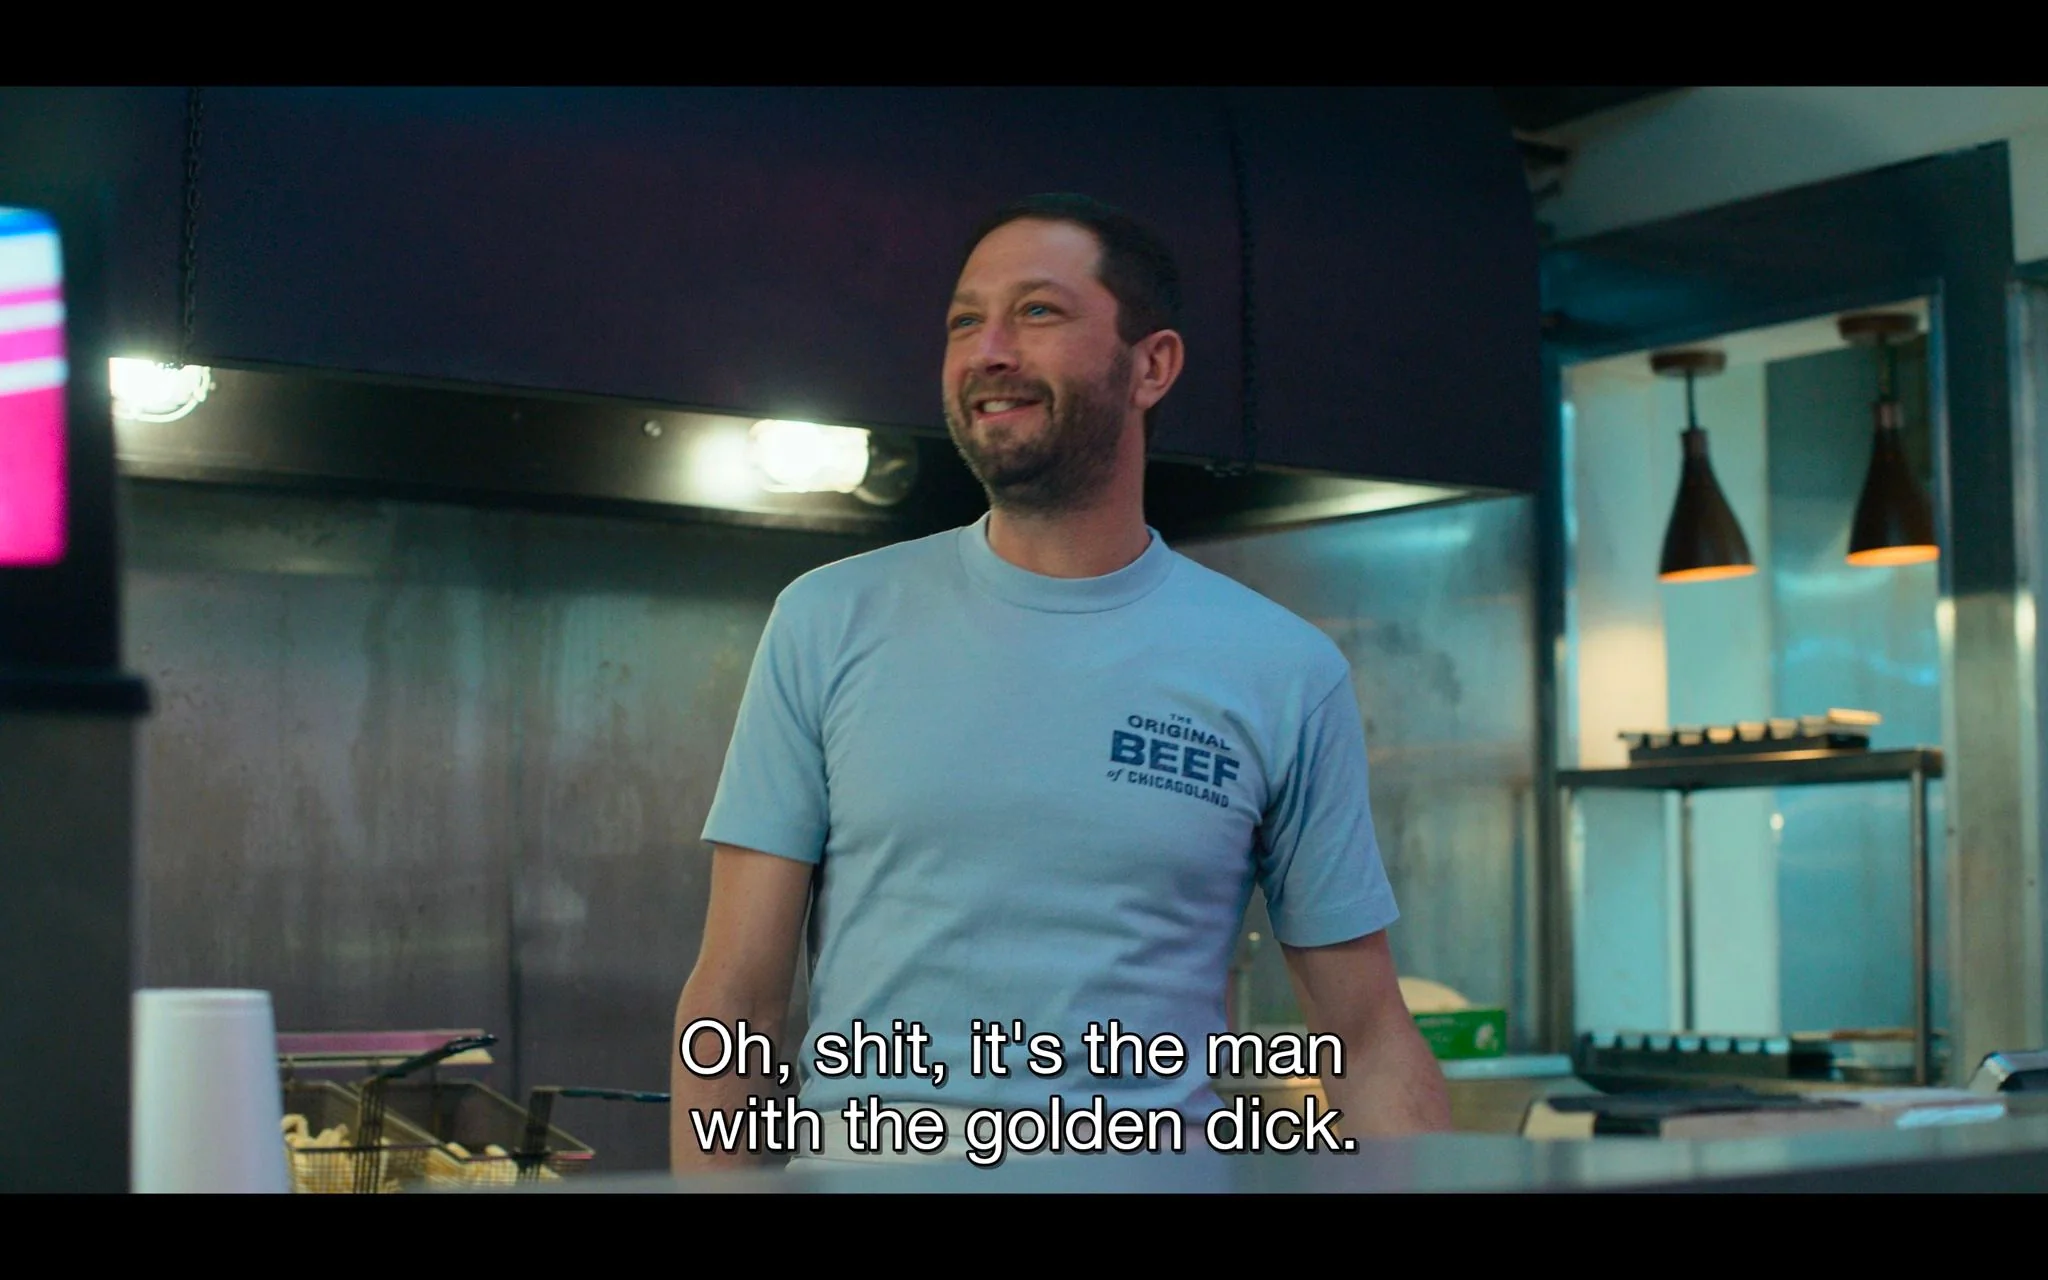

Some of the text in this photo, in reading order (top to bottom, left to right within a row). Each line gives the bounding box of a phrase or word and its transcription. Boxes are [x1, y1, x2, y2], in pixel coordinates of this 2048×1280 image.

[1127, 714, 1232, 751] ORIGINAL
[1170, 713, 1192, 724] THE
[1109, 729, 1240, 788] BEEF
[1106, 768, 1230, 808] of CHICAGOLAND
